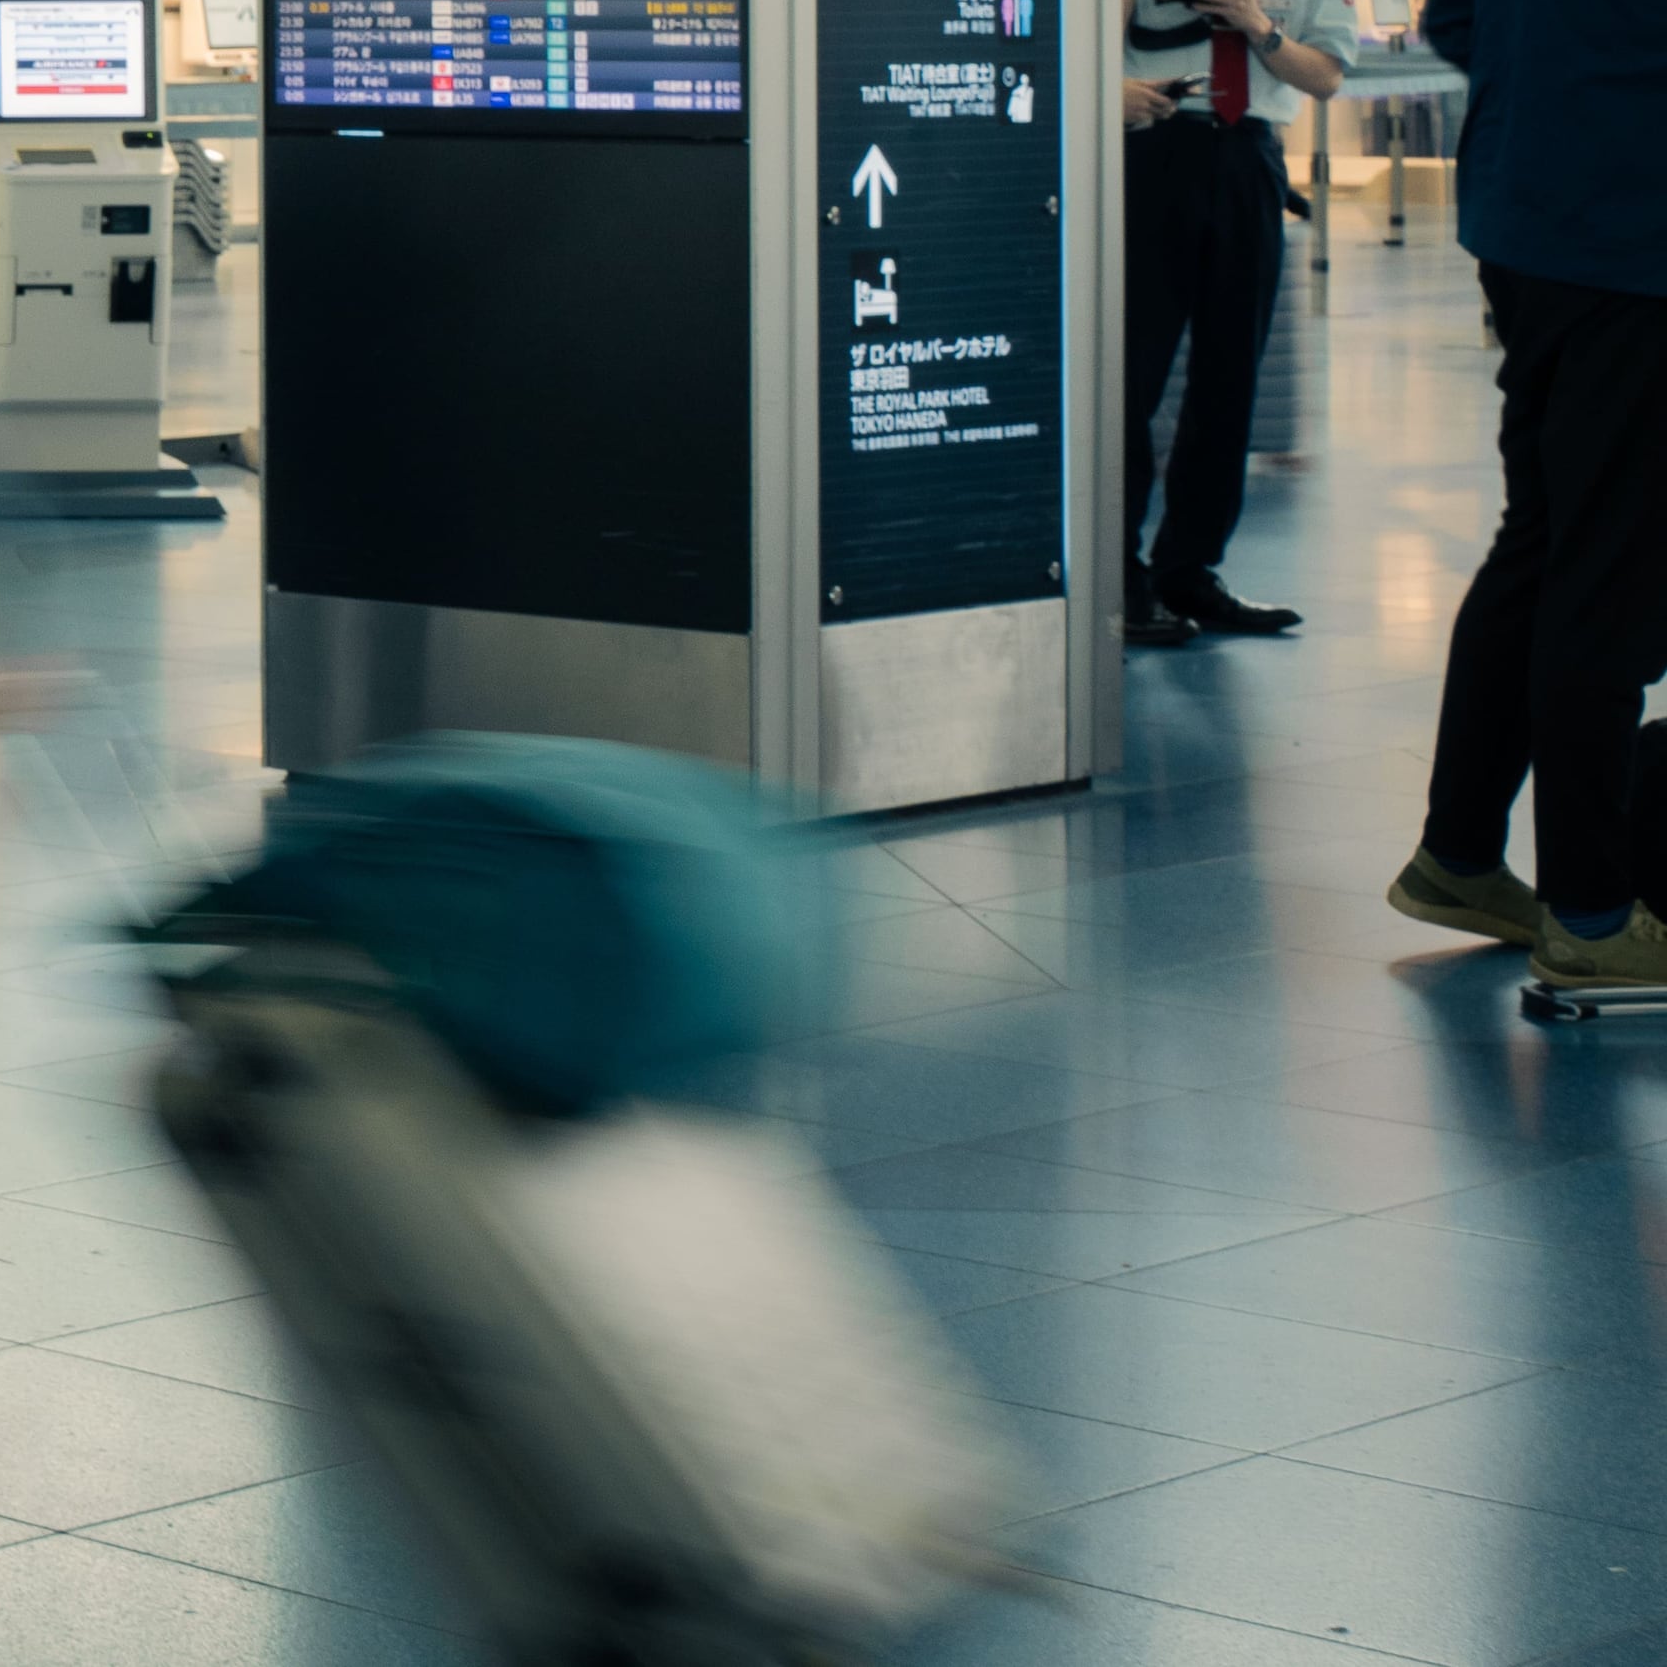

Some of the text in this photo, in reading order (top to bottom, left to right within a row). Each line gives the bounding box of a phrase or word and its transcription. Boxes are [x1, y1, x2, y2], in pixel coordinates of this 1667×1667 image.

[959, 2, 995, 19] Toilets
[870, 335, 1011, 365] ロイヤルパークホテル
[851, 387, 990, 414] THE ROYAL PARK HOTEL
[851, 410, 948, 435] TOKYO HANEDA
